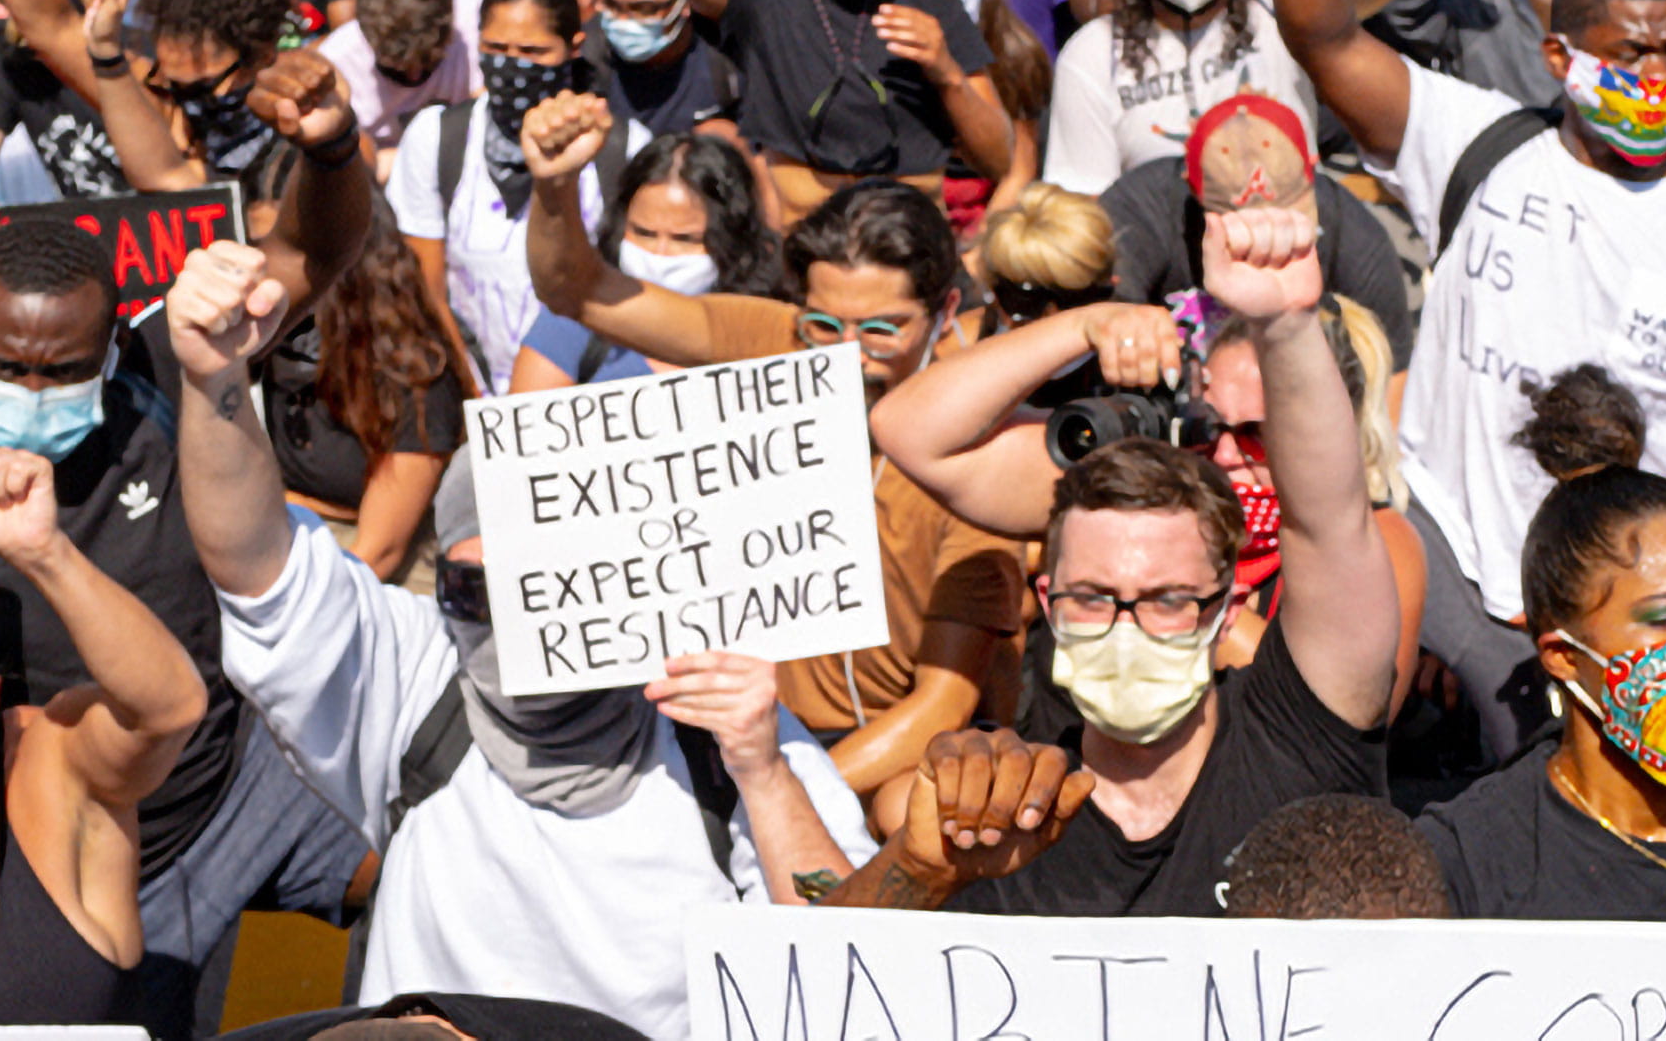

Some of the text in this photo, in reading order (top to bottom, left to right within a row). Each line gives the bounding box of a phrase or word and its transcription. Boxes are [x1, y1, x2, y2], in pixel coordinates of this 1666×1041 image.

[478, 353, 836, 459] RESPECT THEIR
[528, 419, 825, 524] EXISTENCE
[519, 509, 847, 614] EXPECT OUR
[638, 508, 707, 551] OR
[539, 563, 863, 678] RESISTANCE
